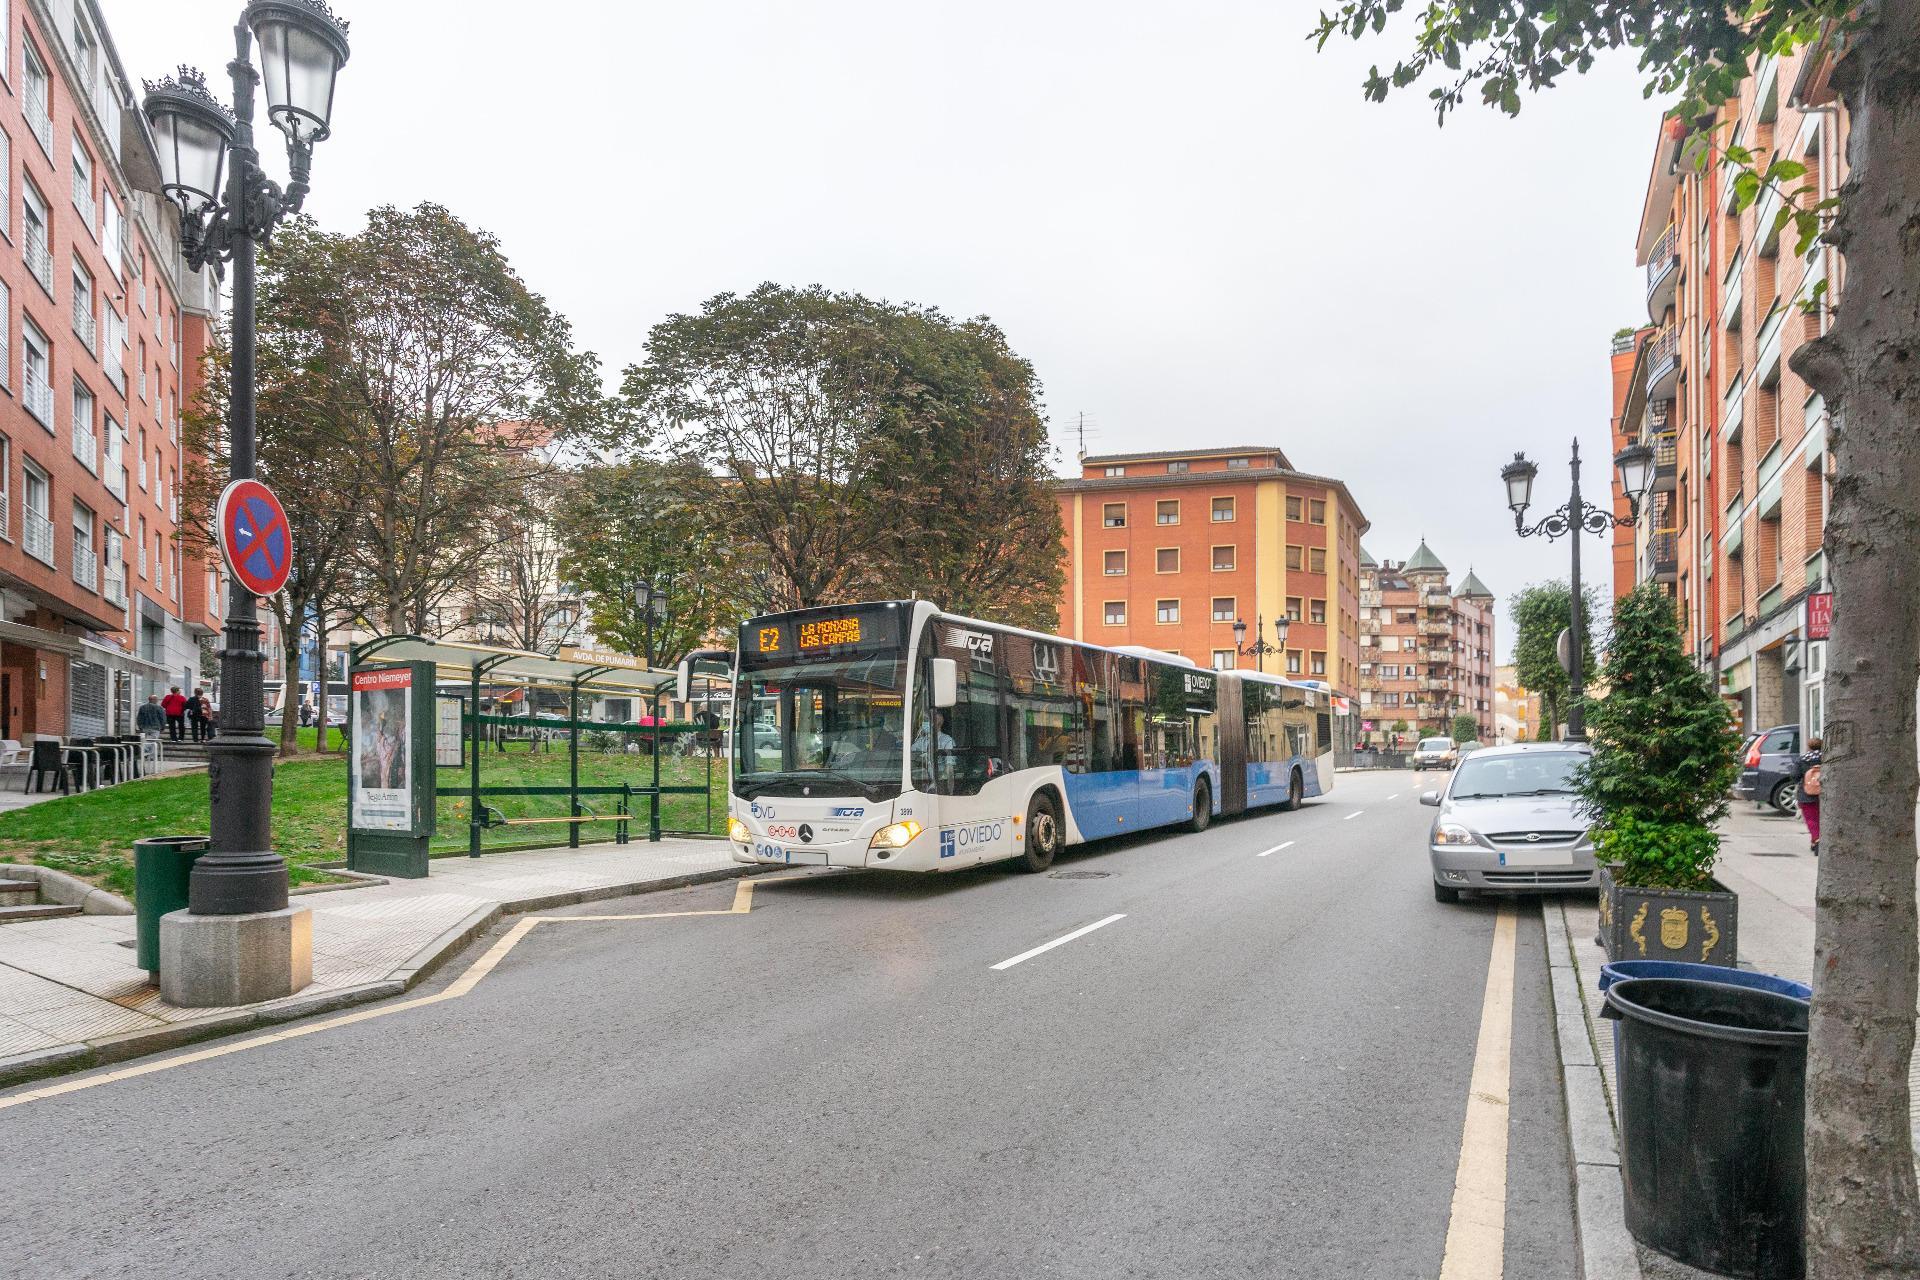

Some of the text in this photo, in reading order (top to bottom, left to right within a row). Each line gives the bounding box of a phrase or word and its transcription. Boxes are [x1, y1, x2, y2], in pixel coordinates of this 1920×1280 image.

[801, 624, 815, 636] LA
[760, 627, 779, 652] E2
[800, 629, 861, 648] LAS CAMPAS
[595, 654, 605, 663] DE
[354, 672, 412, 685] Centro Niemeyer
[958, 823, 1002, 846] OVIEDO
